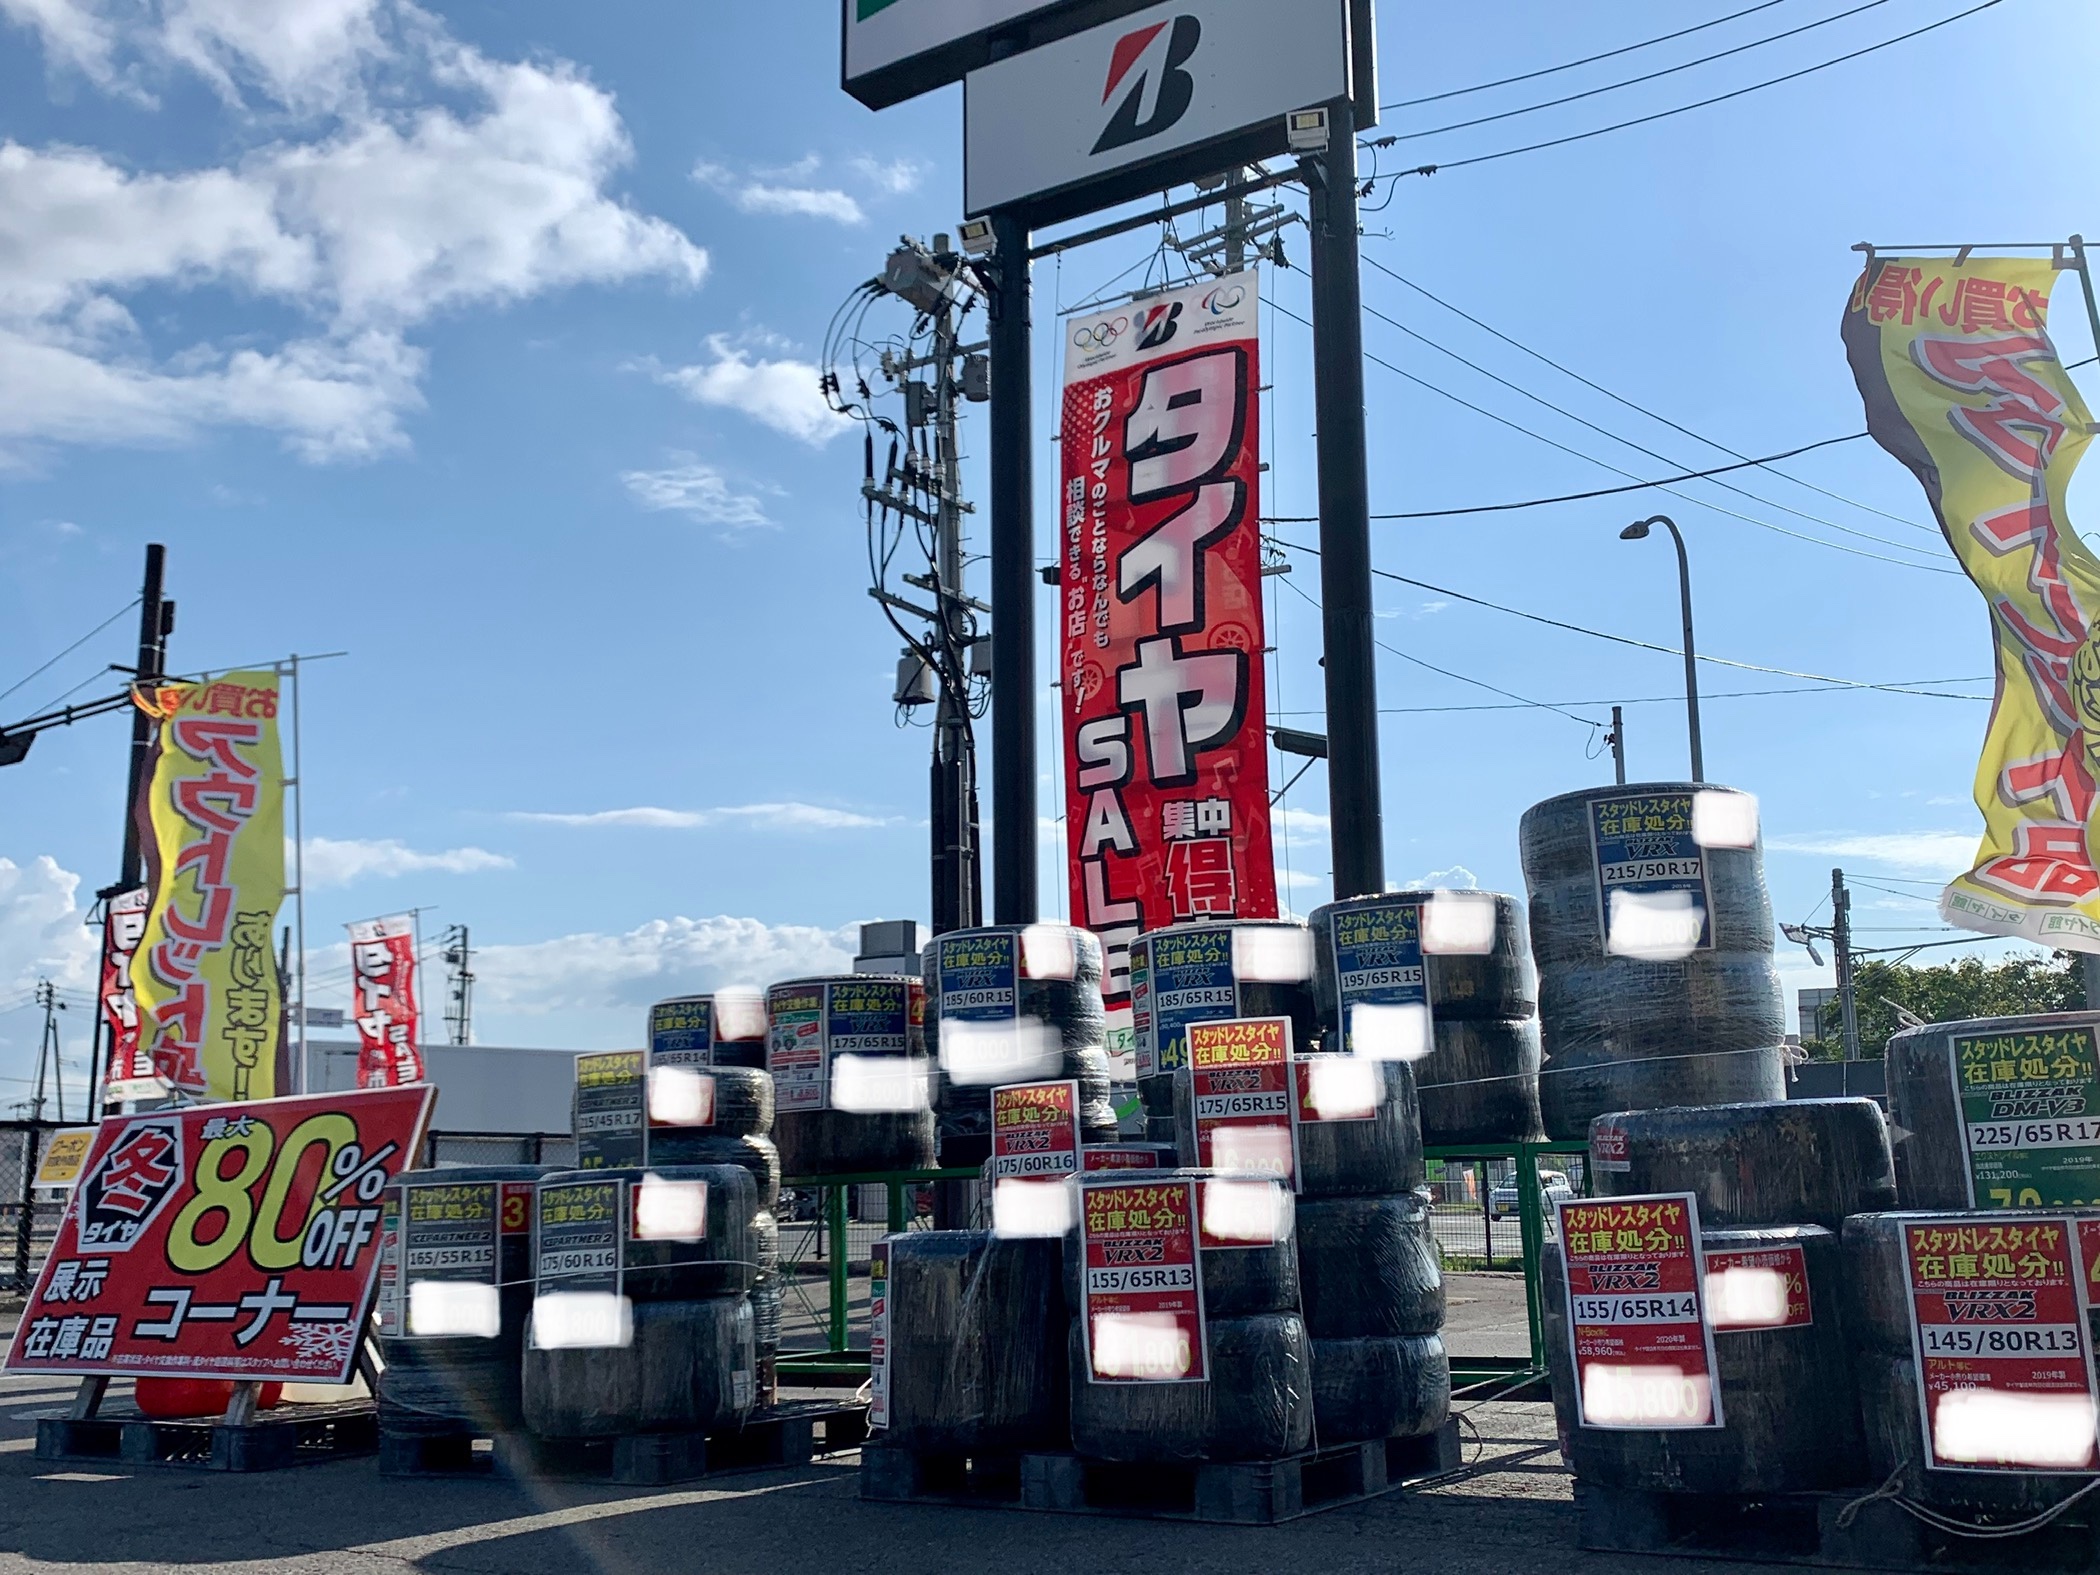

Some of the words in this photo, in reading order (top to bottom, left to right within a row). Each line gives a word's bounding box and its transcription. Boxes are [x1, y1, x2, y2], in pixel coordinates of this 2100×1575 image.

[1122, 348, 1243, 786] タイヤ
[1163, 798, 1231, 840] 集中
[1598, 798, 1691, 819] スタッドレスタイヤ
[1078, 716, 1139, 994] SALE
[1624, 842, 1679, 860] VRX
[1336, 909, 1414, 929] スタッドレスタイヤ
[1155, 933, 1227, 951] スタッドレスタイヤ
[1194, 1023, 1280, 1046] スタッドレスタイヤ
[1961, 1032, 2087, 1060] スタッドレスタイヤ
[1208, 1069, 1262, 1078] BLIZZAK
[996, 1087, 1068, 1109] スタッドレスタイヤ
[1199, 1095, 1287, 1115] 175/65R15
[1989, 1085, 2084, 1102] BLIZZAK
[1991, 1097, 2087, 1118] DM-V3
[201, 1117, 257, 1140] 最大
[1005, 1130, 1050, 1139] BLIZZAK
[98, 1128, 176, 1218] 冬
[998, 1154, 1073, 1175] 175/60R16
[1087, 1187, 1185, 1210] スタッドレスタイヤ
[1567, 1203, 1681, 1229] スタッドレスタイヤ
[84, 1221, 141, 1244] タイヤ
[302, 1208, 386, 1269] OFF
[1103, 1238, 1165, 1248] BLIZZAK
[1913, 1226, 2060, 1252] スタッドレスタイヤ
[1104, 1246, 1165, 1265] VRX2
[1588, 1262, 1661, 1273] BLIZZAK
[43, 1258, 110, 1302] 展示
[1091, 1269, 1193, 1290] 155/65R13
[1588, 1271, 1661, 1293] VRX2
[1943, 1289, 2037, 1301] BLIZZAK
[134, 1280, 351, 1347] コーナー
[1577, 1298, 1696, 1322] 155/65R14
[1944, 1299, 2038, 1322] VRX2
[24, 1316, 119, 1361] 在庫品
[1928, 1330, 2078, 1354] 145/80R13
